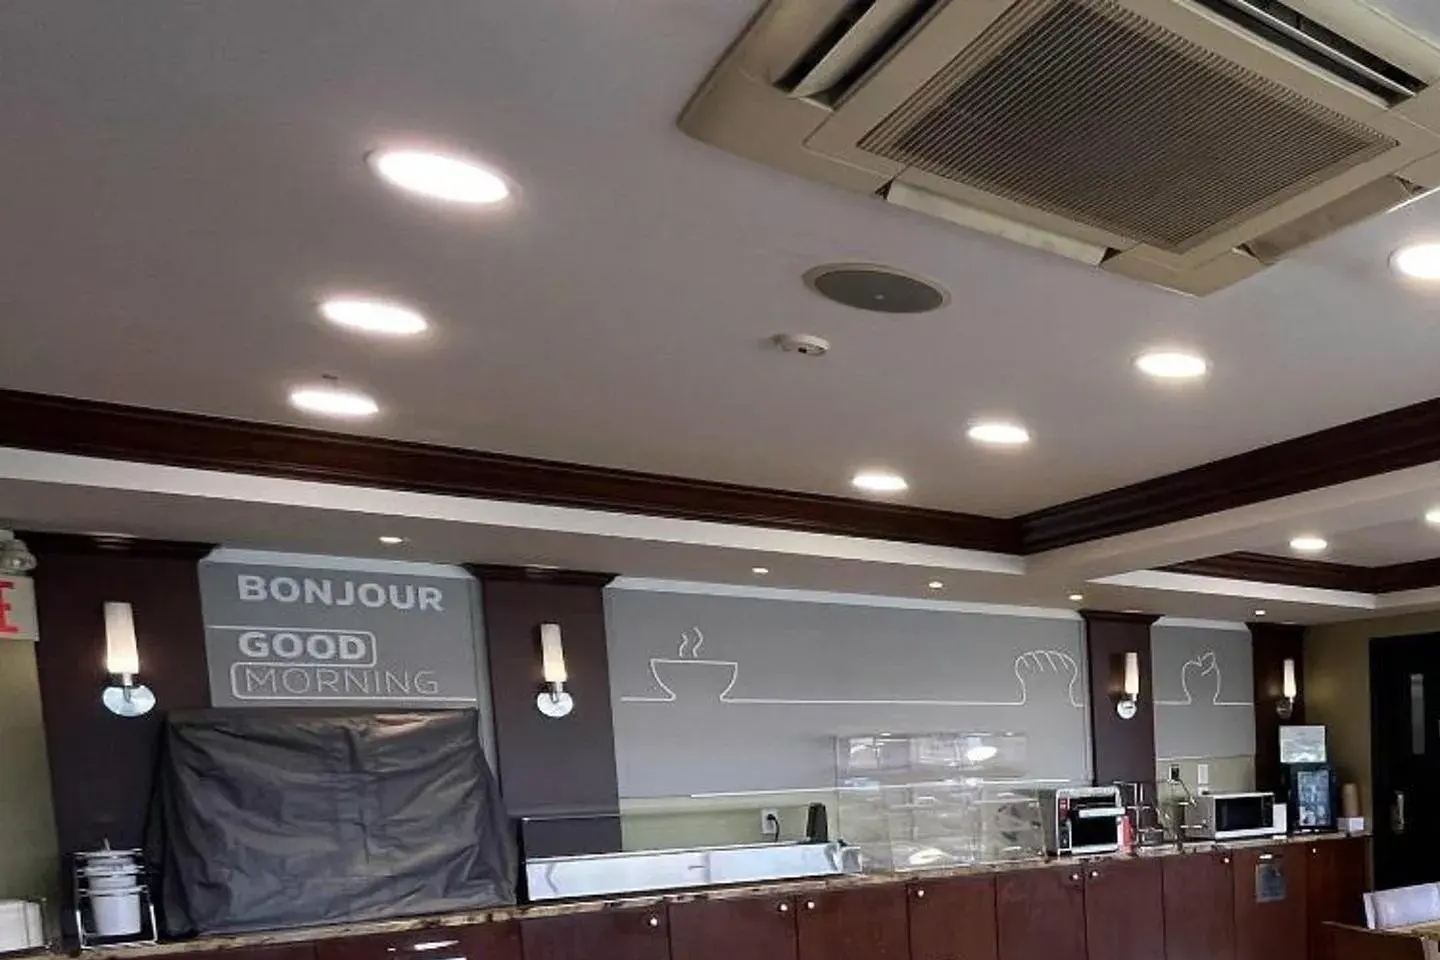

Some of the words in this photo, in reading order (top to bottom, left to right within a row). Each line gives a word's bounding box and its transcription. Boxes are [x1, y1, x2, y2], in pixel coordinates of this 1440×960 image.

[237, 574, 444, 612] BONJOUR
[238, 631, 366, 660] GOOD
[245, 667, 439, 694] MORNING
